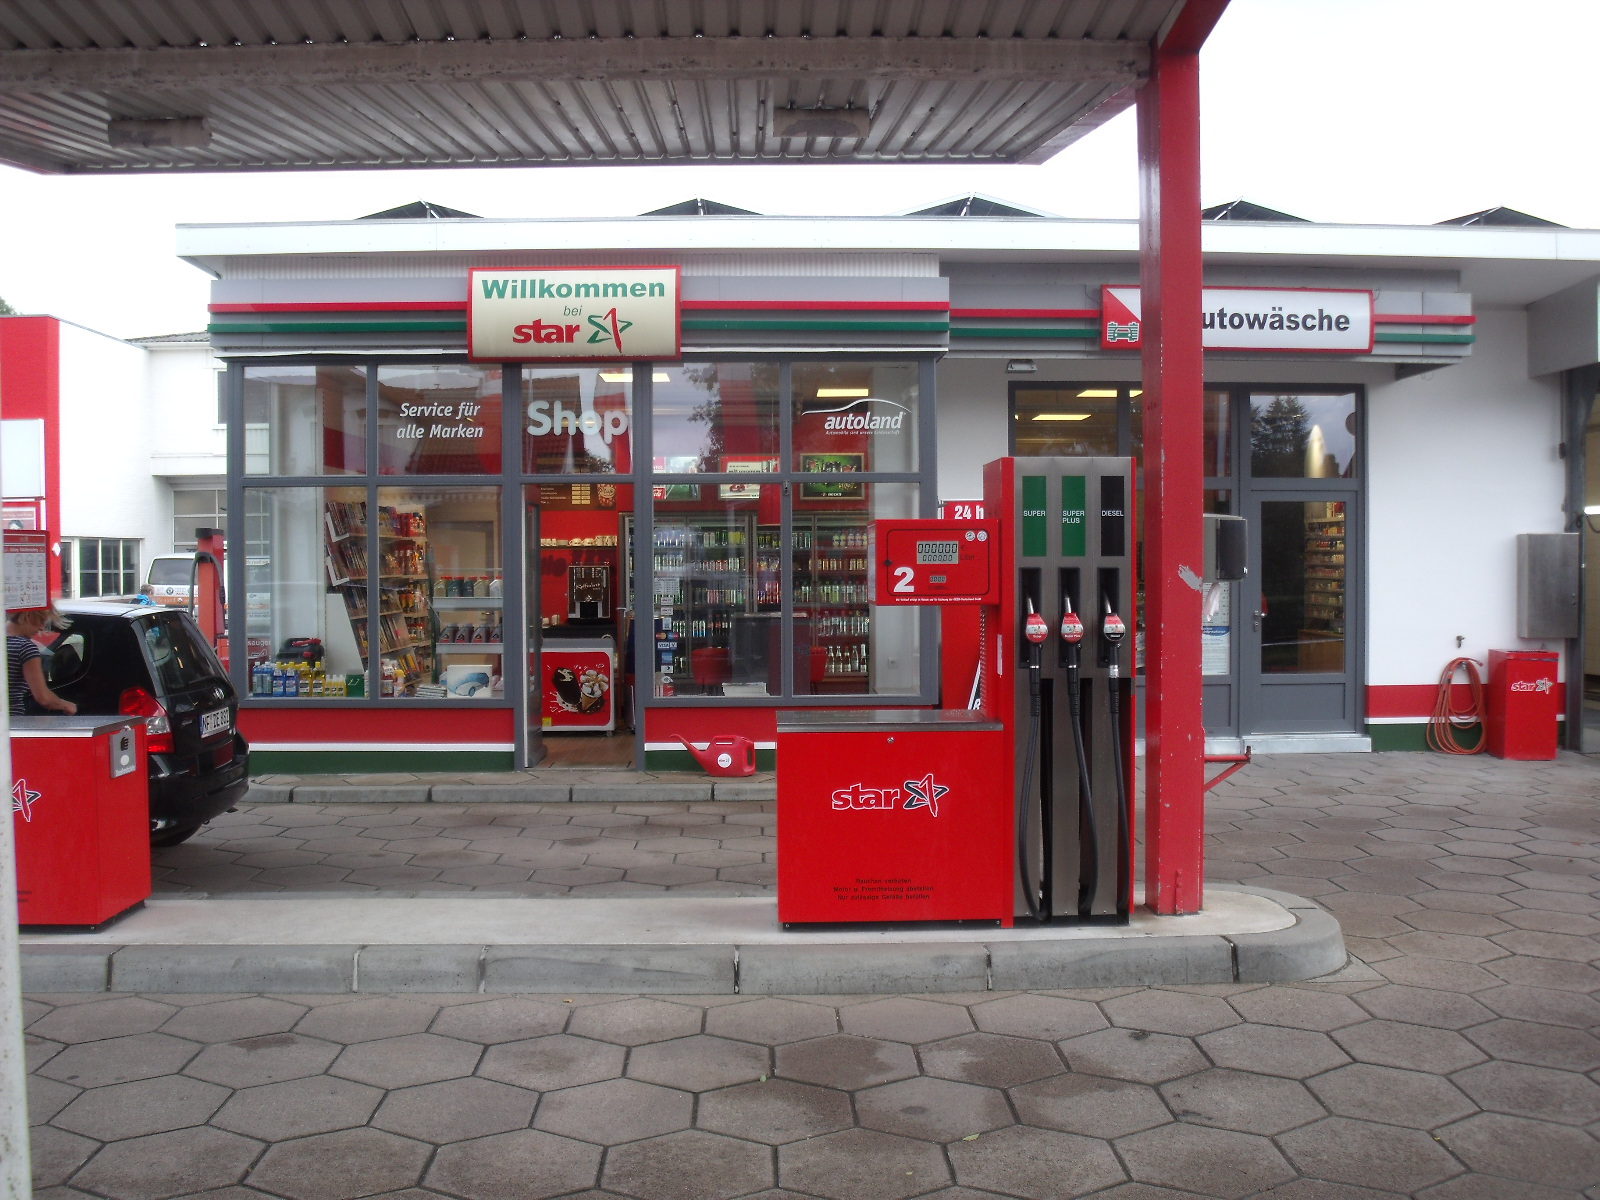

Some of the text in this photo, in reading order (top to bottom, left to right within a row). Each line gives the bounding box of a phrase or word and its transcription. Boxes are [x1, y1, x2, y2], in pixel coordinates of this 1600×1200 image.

[481, 279, 665, 299] Willkommen
[563, 305, 583, 317] bei
[1202, 306, 1350, 331] utowäsche
[512, 318, 580, 344] star
[400, 402, 481, 420] Service für
[824, 411, 904, 430] autoland
[396, 424, 484, 439] alle Marken
[527, 400, 628, 445] Shop
[954, 505, 984, 520] 24 h
[893, 566, 915, 593] 2
[1511, 681, 1536, 692] star
[831, 783, 900, 810] star
